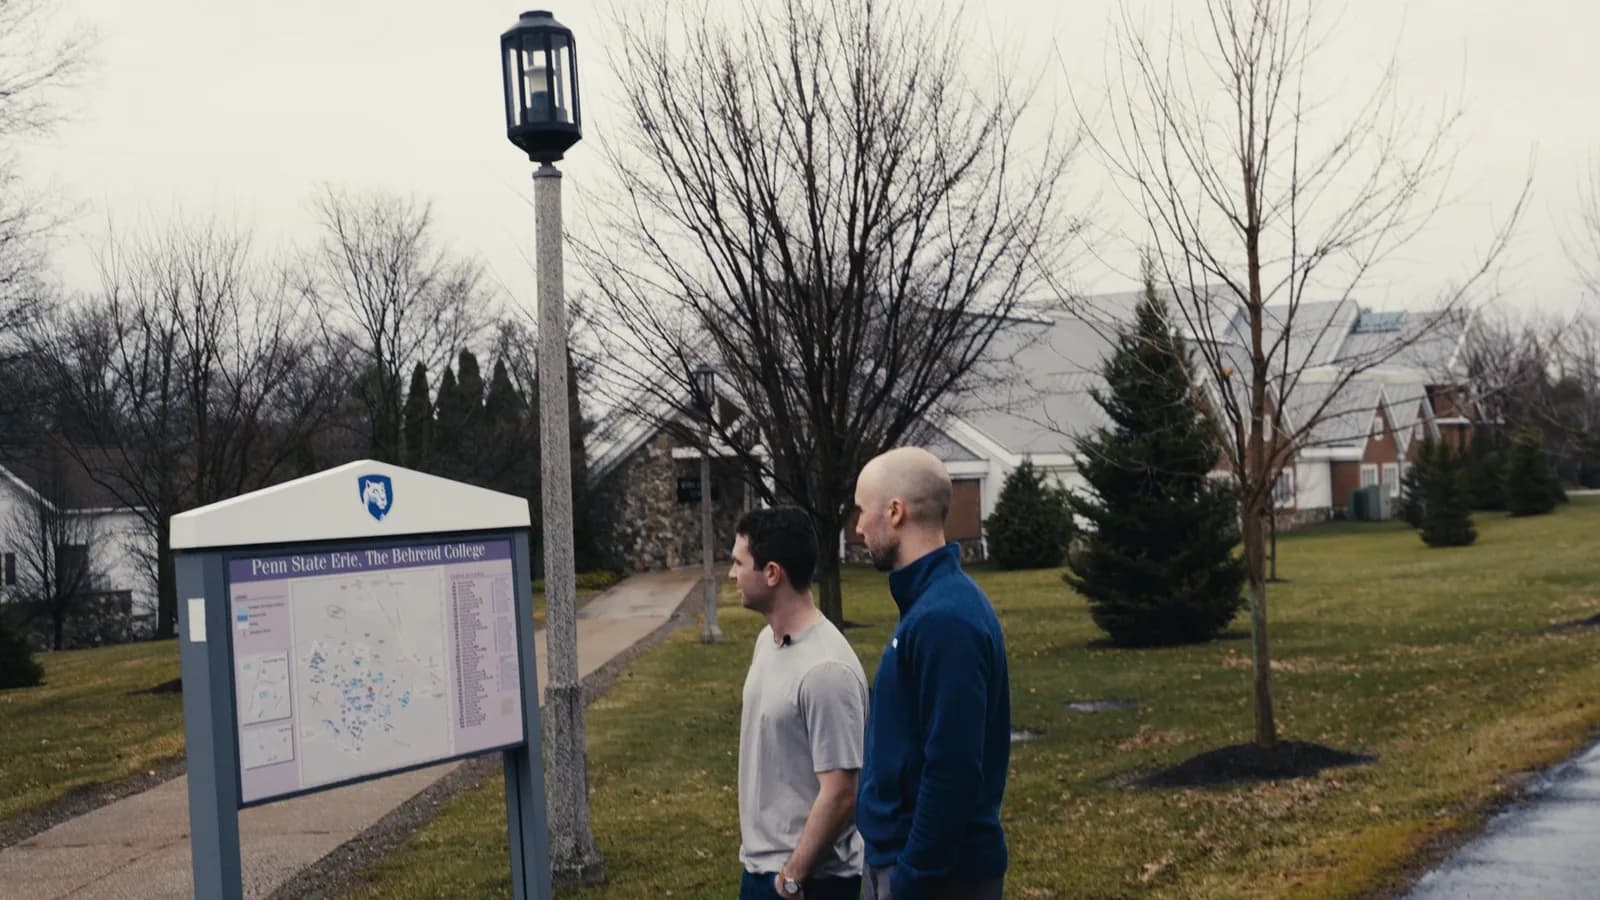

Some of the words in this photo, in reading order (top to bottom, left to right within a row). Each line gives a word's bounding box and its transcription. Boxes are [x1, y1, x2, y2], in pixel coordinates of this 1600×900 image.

[252, 559, 288, 576] Penn
[291, 556, 326, 572] State
[365, 549, 389, 566] The
[392, 546, 441, 563] Behrend
[444, 543, 485, 560] College
